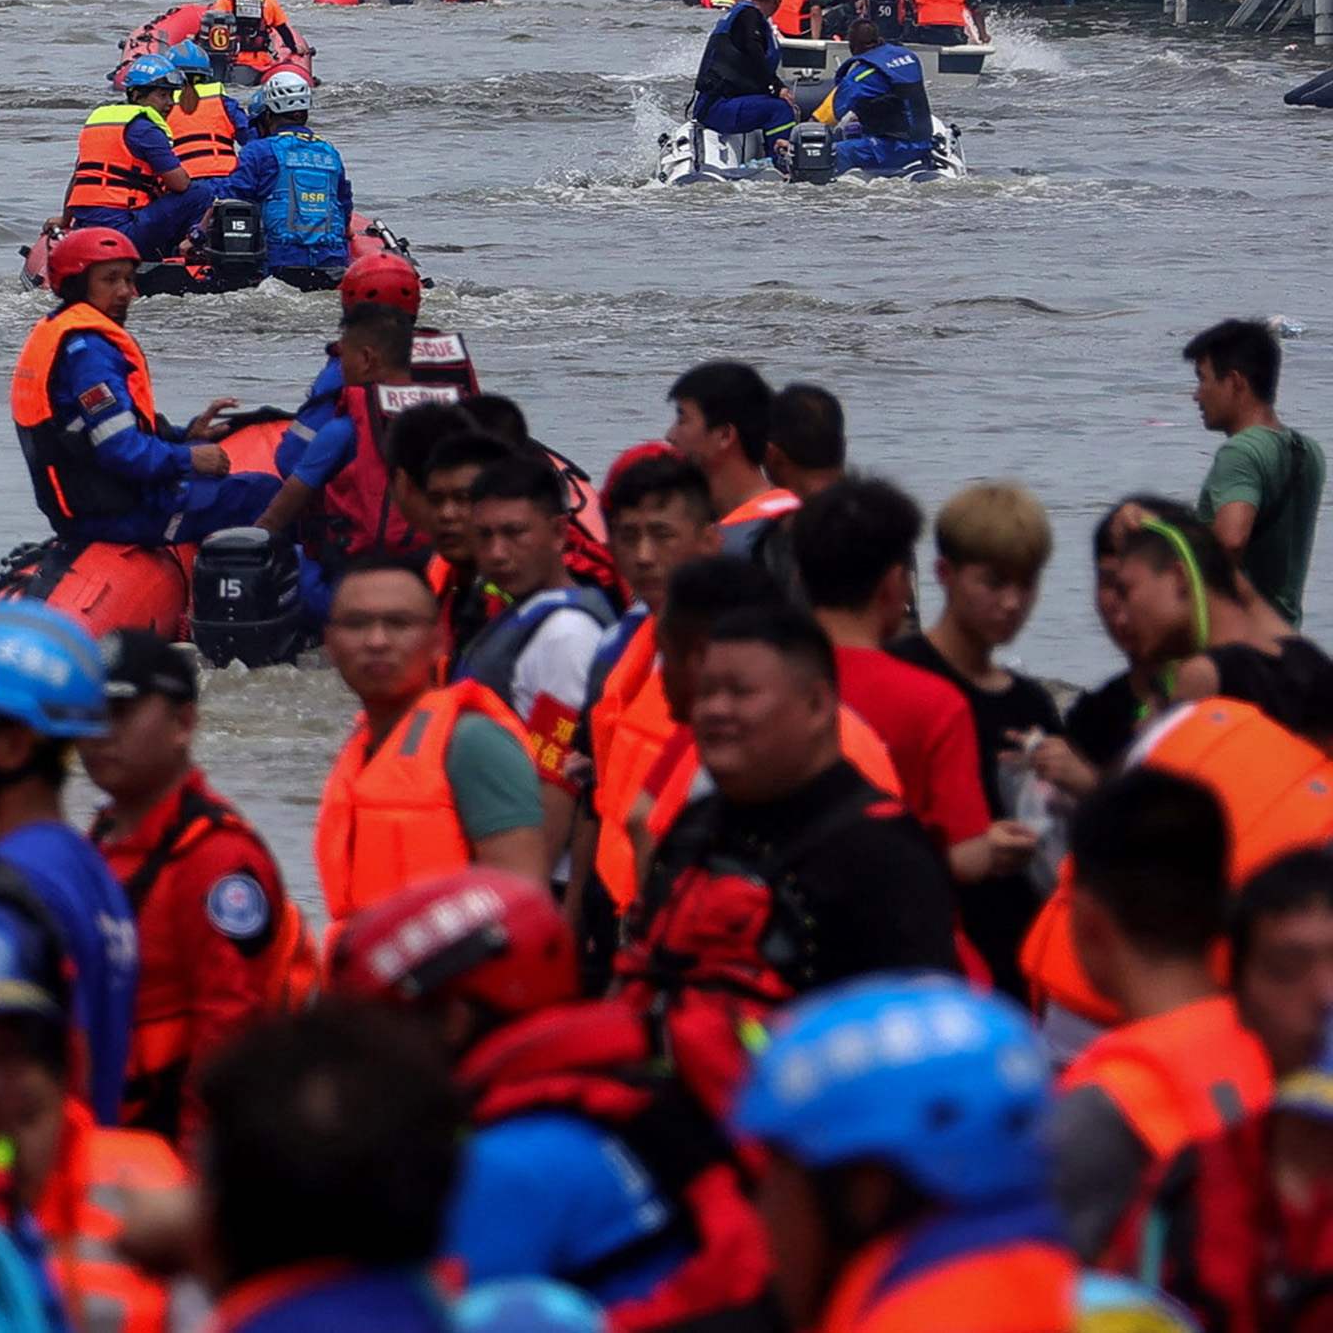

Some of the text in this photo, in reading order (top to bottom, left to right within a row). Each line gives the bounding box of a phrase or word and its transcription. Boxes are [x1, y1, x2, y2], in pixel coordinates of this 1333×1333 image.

[878, 5, 892, 17] 50
[213, 28, 228, 47] 6
[301, 192, 325, 203] BSR
[232, 220, 246, 231] 15
[413, 341, 455, 359] SCUE
[219, 577, 242, 598] 15
